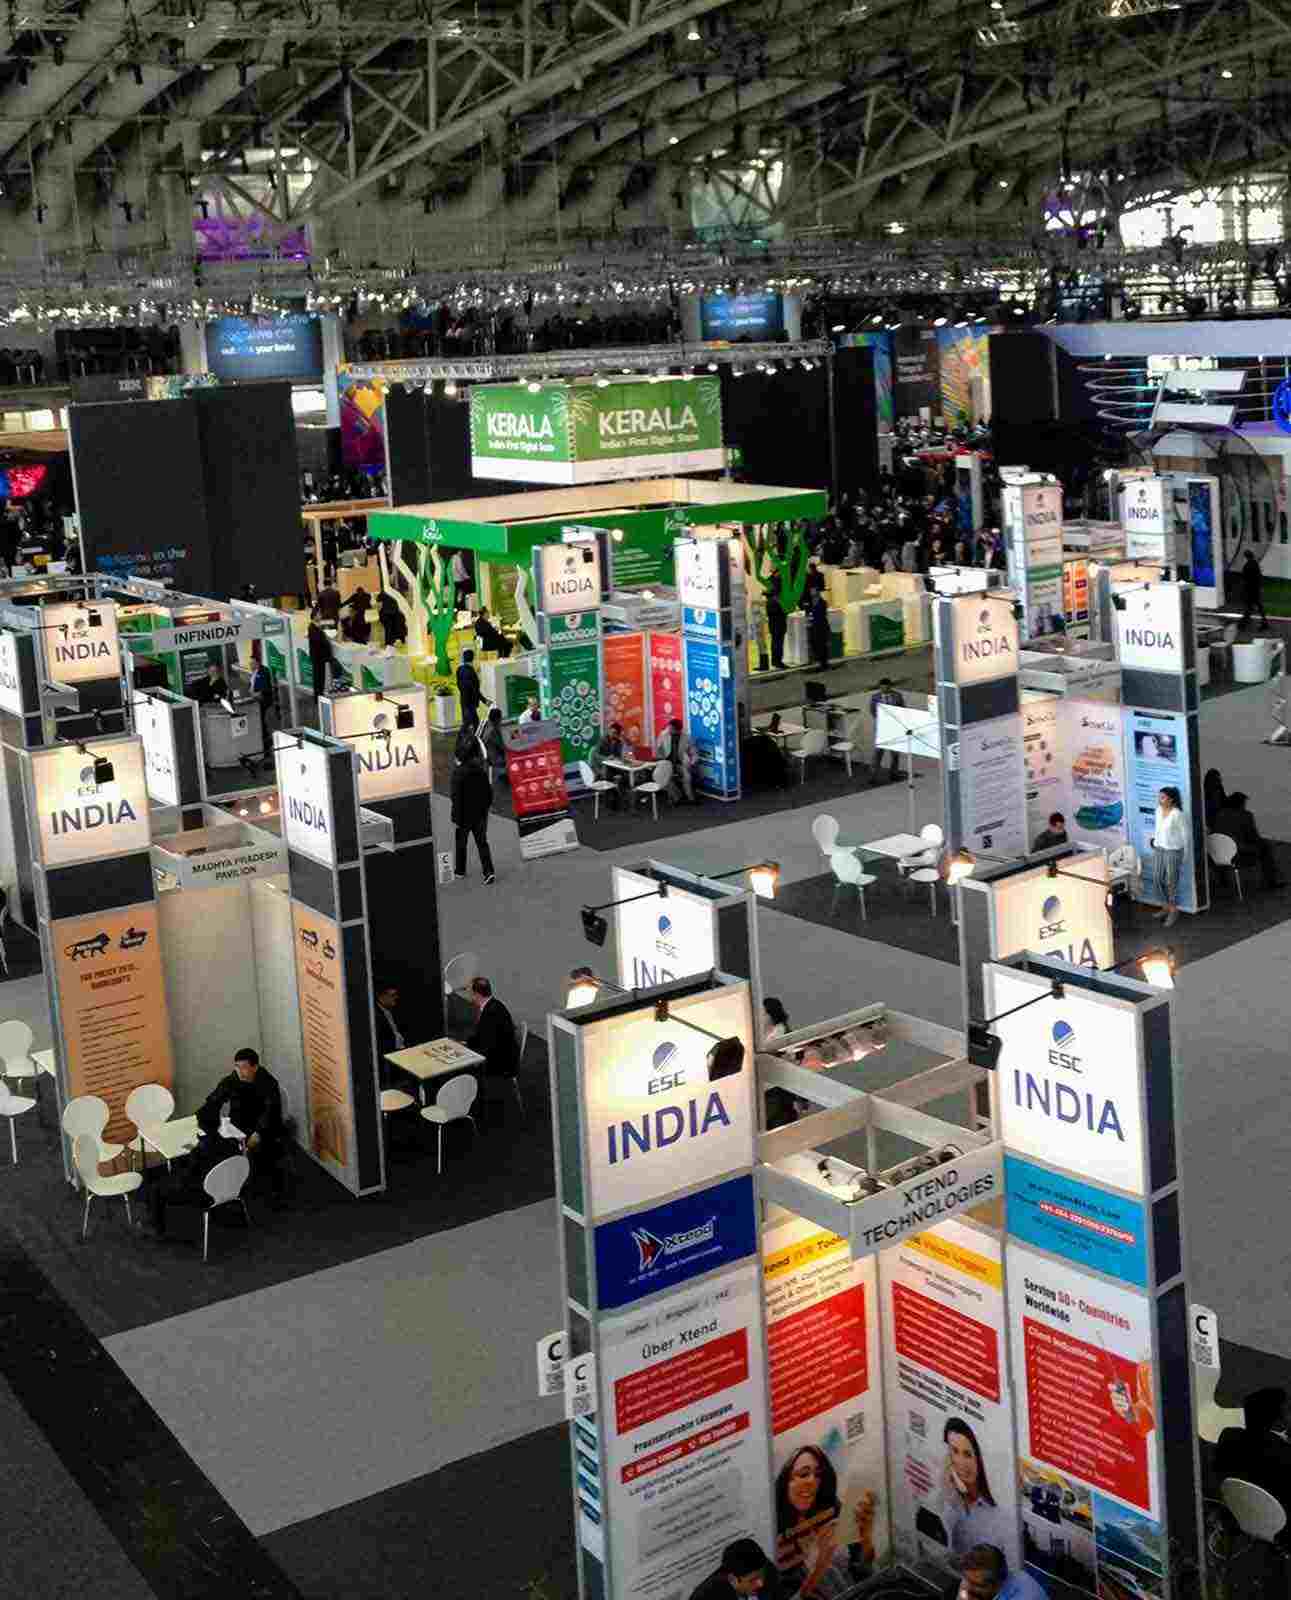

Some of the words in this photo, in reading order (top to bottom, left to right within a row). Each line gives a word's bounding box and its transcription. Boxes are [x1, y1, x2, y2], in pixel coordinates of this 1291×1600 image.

[486, 411, 553, 438] KERALA
[599, 405, 698, 436] KERALA
[1128, 507, 1160, 521] INDIA
[551, 578, 594, 595] INDIA
[174, 624, 241, 645] INFINIDAT
[1126, 629, 1174, 649] INDIA
[56, 641, 111, 662] INDIA
[961, 636, 1011, 661] INDIA
[353, 744, 420, 774] NDIA
[51, 799, 137, 835] INDIA
[288, 796, 328, 834] INDIA
[192, 859, 233, 873] MADHYA
[235, 851, 279, 865] PRADESH
[1048, 1049, 1083, 1074] ESC
[647, 1070, 686, 1096] ESC
[1014, 1069, 1126, 1143] INDIA
[607, 1091, 731, 1165] INDIA
[904, 1169, 958, 1207] XTEND
[863, 1174, 994, 1246] TECHNOLOGIES
[1196, 1314, 1209, 1335] C
[548, 1340, 563, 1361] C
[641, 1339, 675, 1360] Über
[679, 1319, 719, 1344] Xtend
[575, 1363, 587, 1380] C
